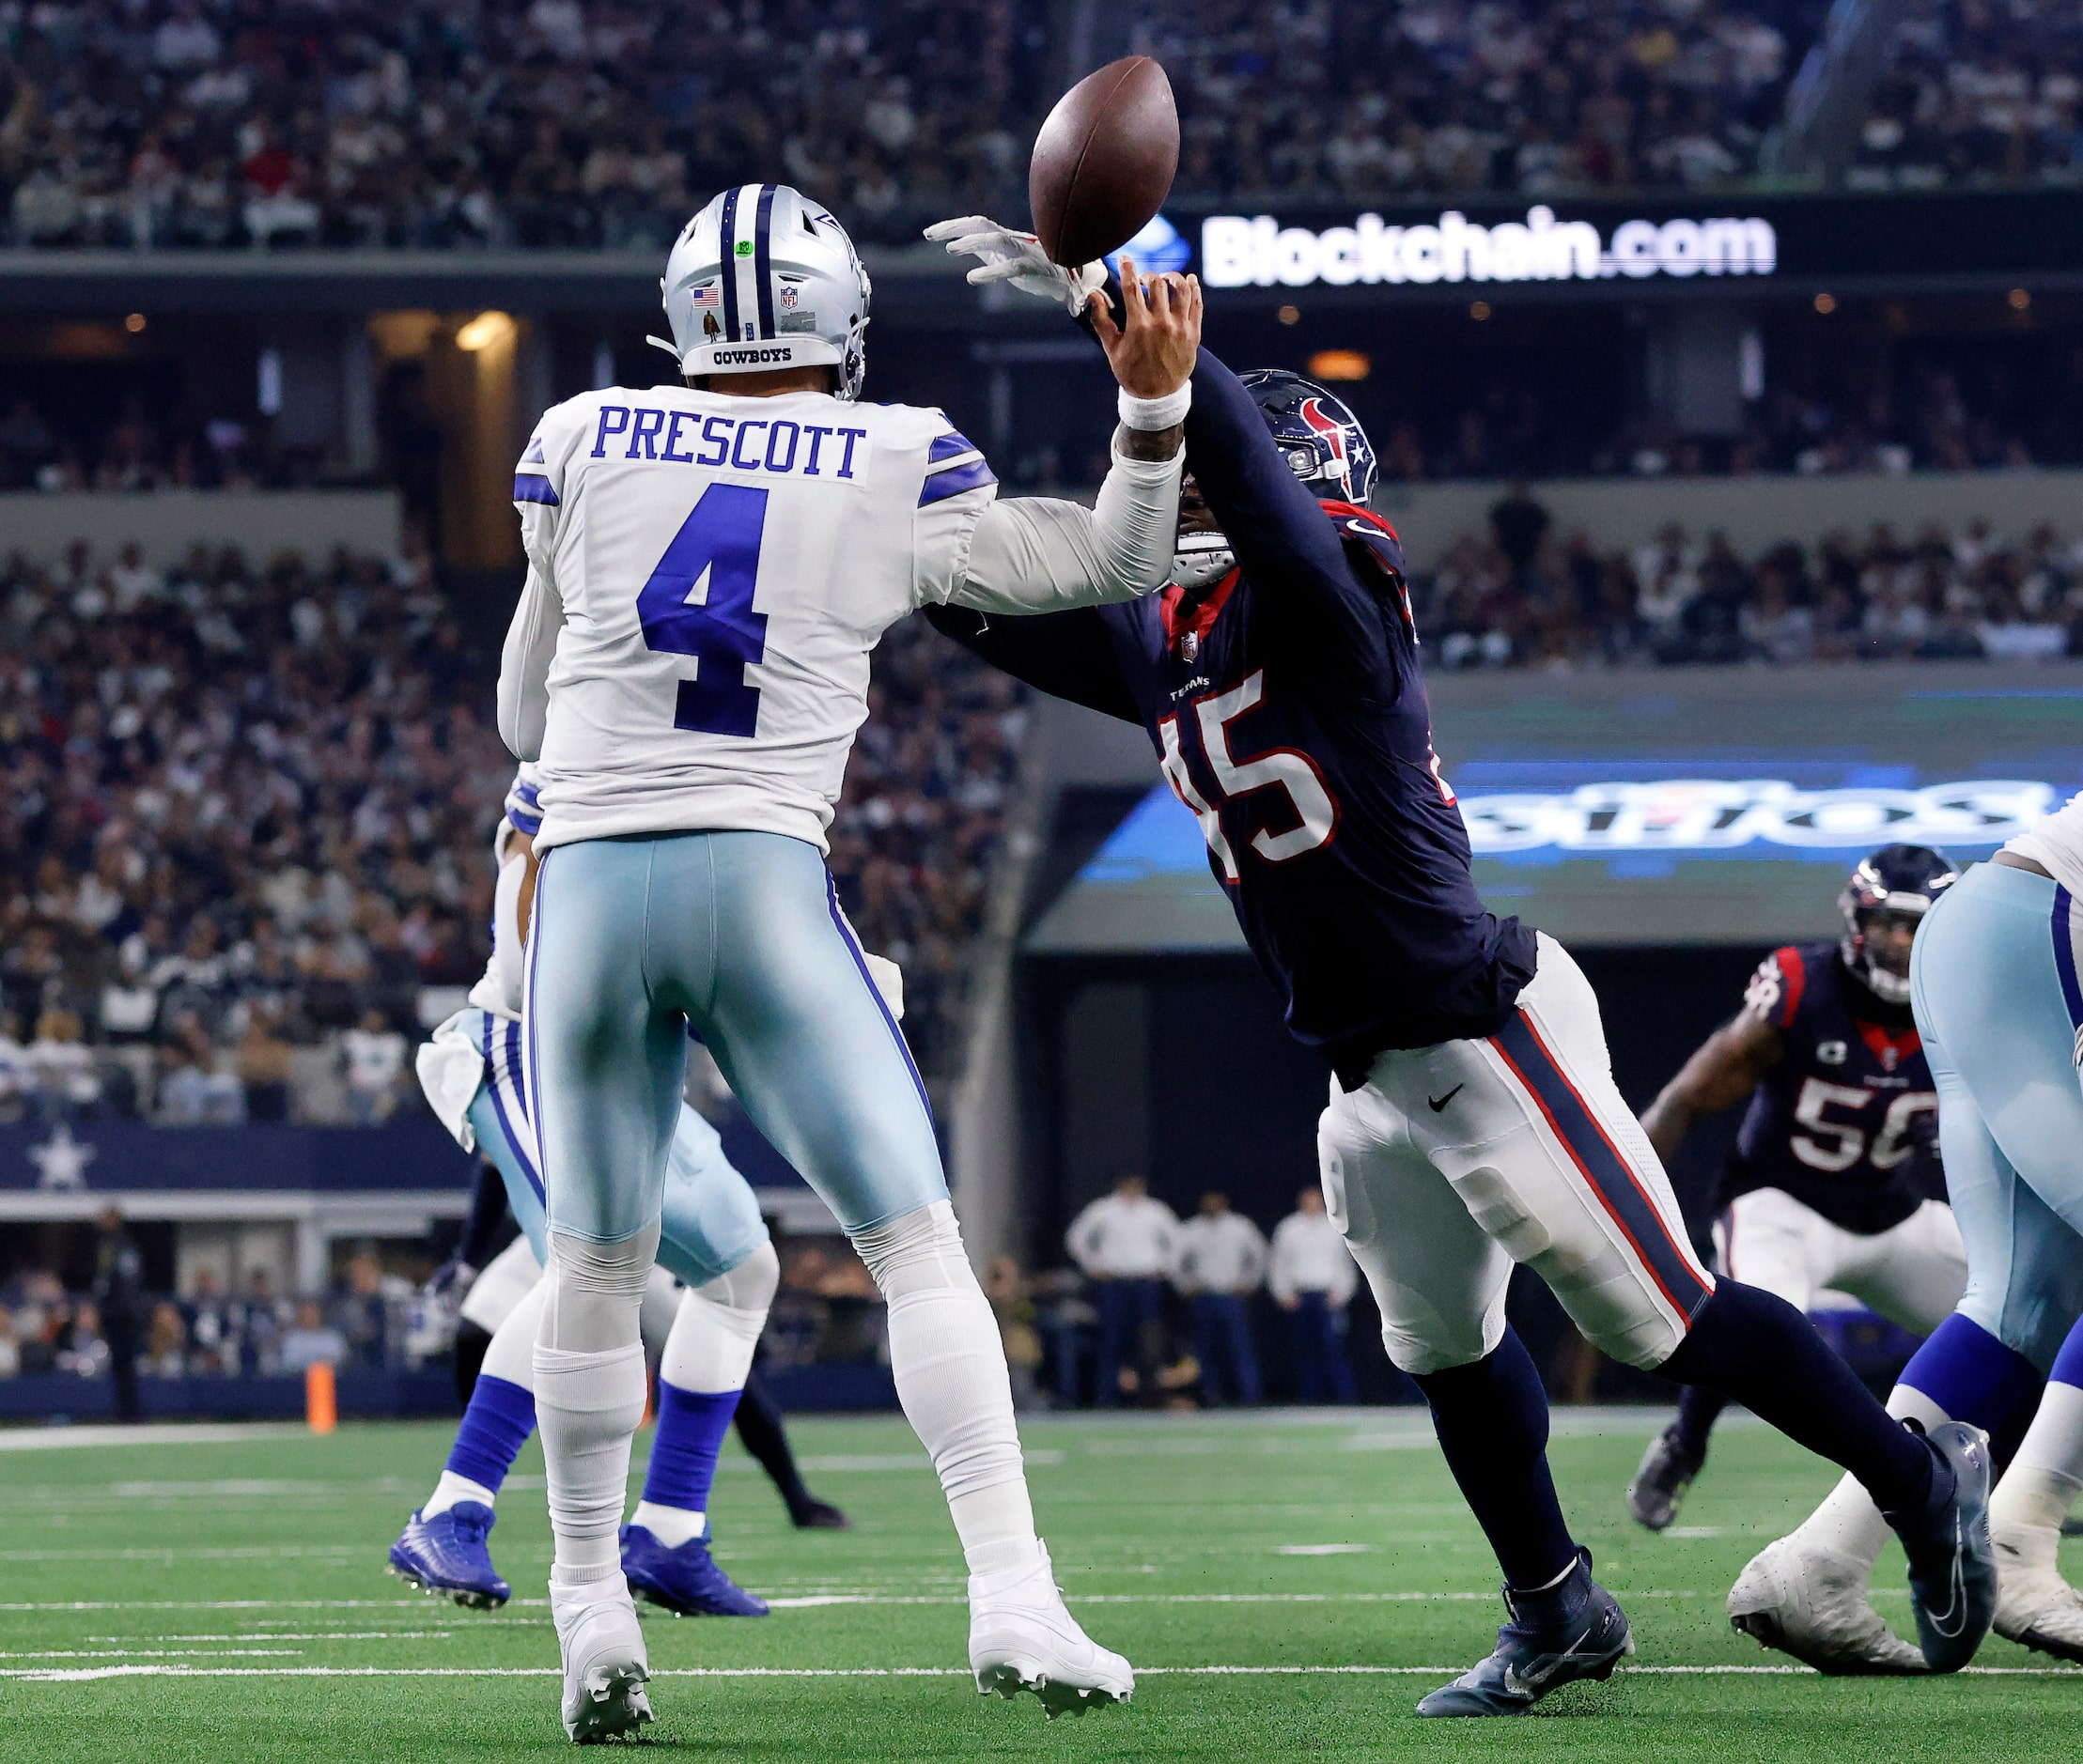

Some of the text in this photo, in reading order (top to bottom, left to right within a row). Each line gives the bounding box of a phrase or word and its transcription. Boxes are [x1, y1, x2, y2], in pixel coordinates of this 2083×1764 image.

[1202, 206, 1777, 287] Blockchain.com
[714, 348, 792, 364] COWBOYS
[590, 406, 867, 478] PRESCOTT
[636, 482, 769, 738] 4
[1169, 675, 1210, 702] TEXANS
